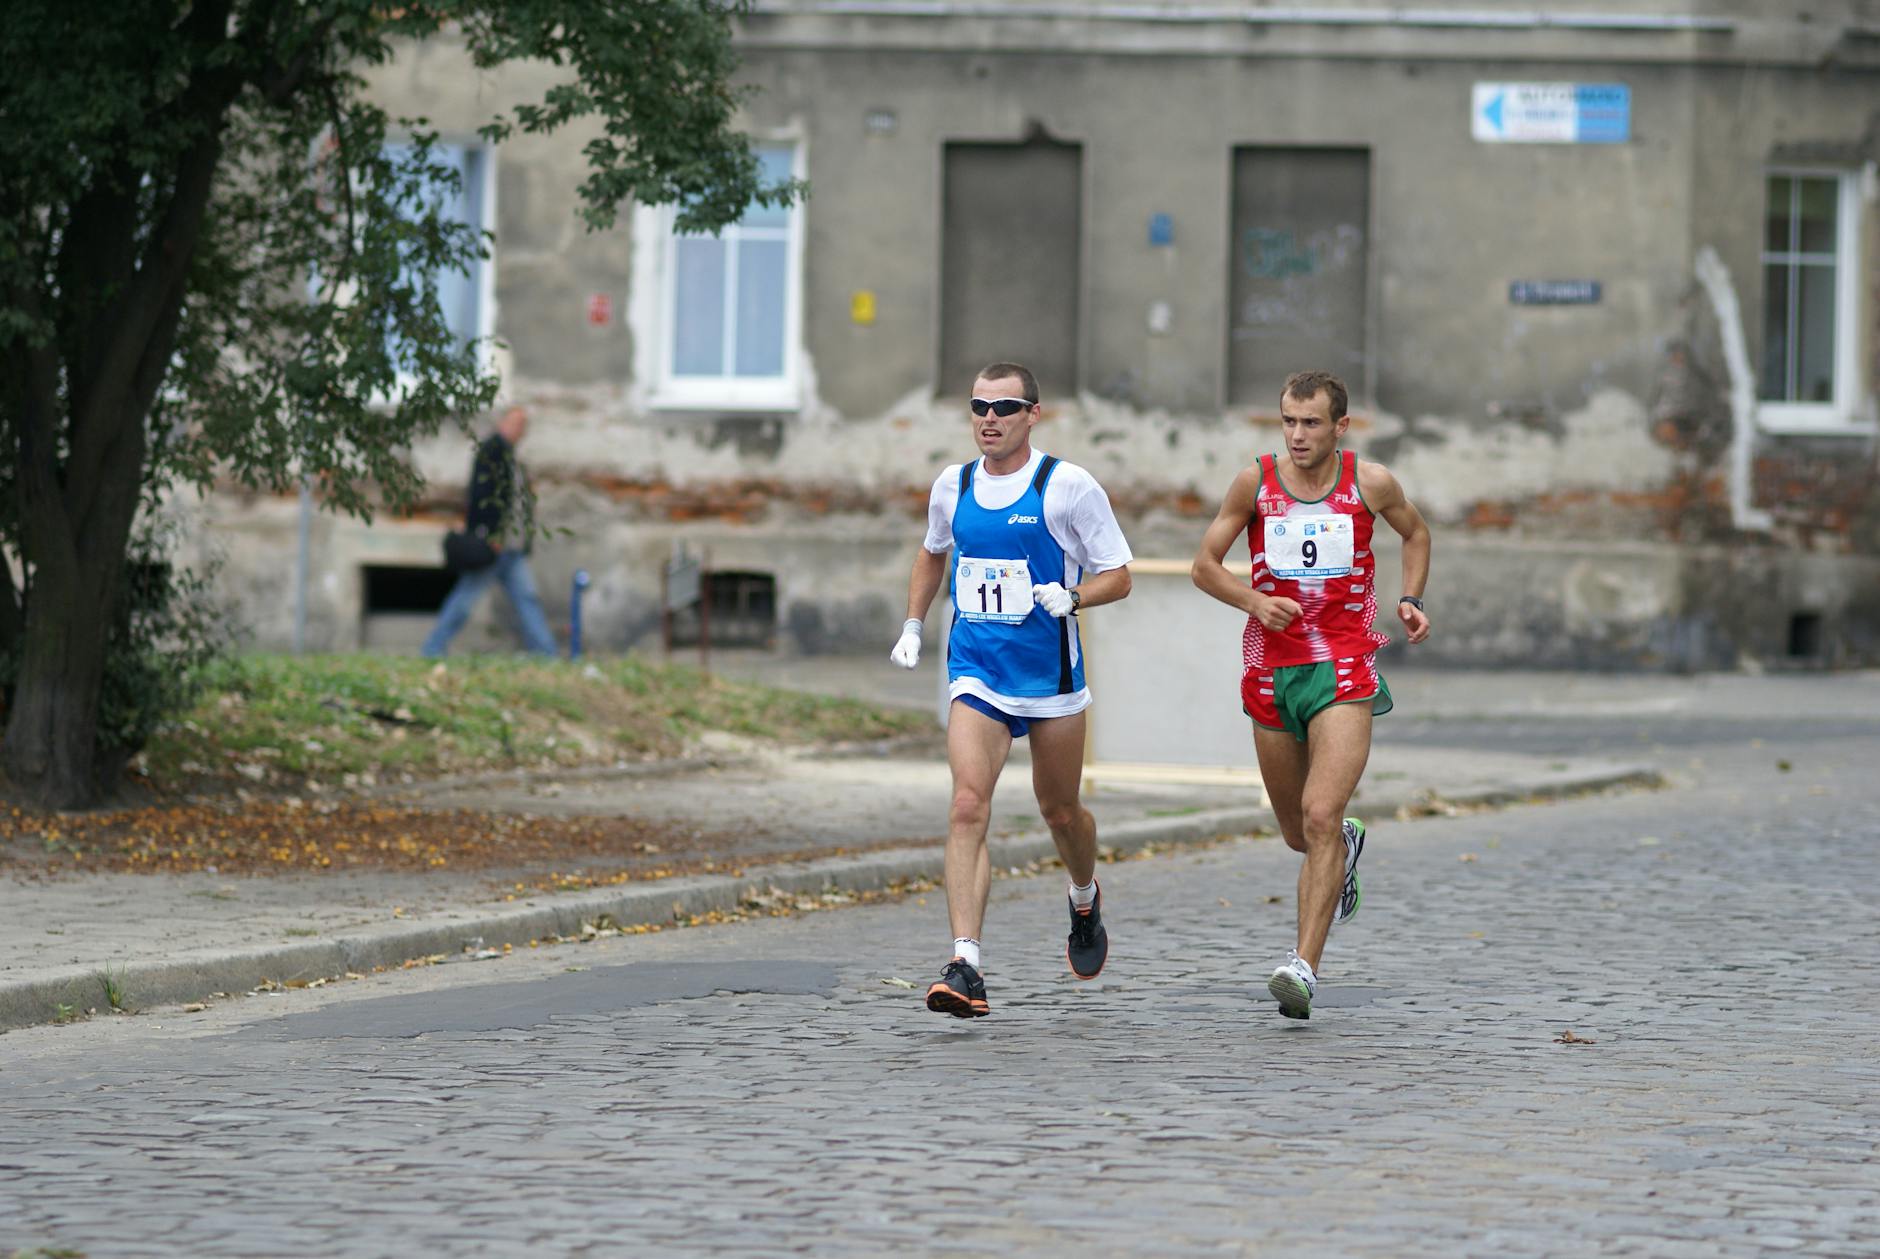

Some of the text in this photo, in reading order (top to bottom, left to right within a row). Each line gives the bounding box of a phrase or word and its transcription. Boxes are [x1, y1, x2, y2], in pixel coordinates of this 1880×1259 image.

[1259, 501, 1287, 515] BLR
[1334, 493, 1358, 505] FILA
[1301, 540, 1317, 568] 9
[977, 583, 1002, 613] 11
